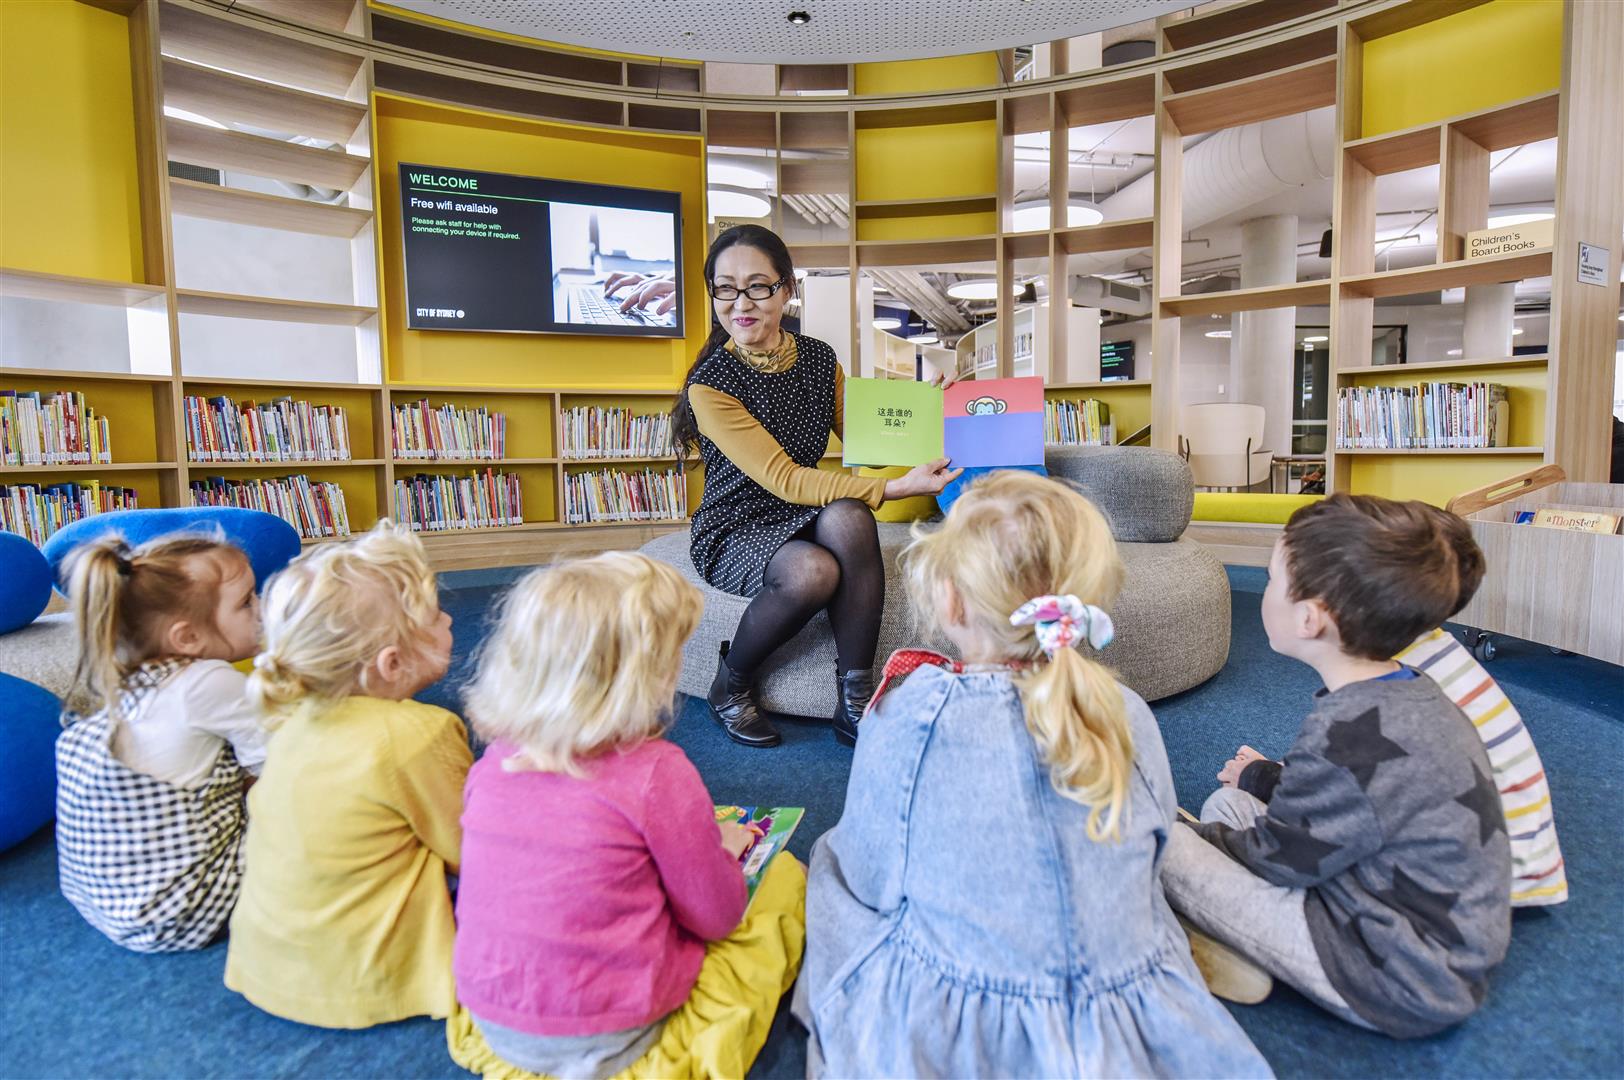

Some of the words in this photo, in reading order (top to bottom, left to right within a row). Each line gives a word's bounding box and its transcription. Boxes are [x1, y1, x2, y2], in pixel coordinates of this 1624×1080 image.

[409, 173, 478, 190] WELCOME
[410, 197, 434, 209] Free
[436, 200, 453, 211] wifi
[455, 203, 498, 215] available
[411, 216, 434, 226] Please
[448, 220, 462, 228] staff
[473, 222, 487, 230] help
[488, 223, 502, 231] with
[412, 226, 449, 236] connecting
[466, 229, 487, 237] device
[493, 232, 521, 240] required.
[1471, 232, 1521, 248] Children's
[1471, 245, 1501, 257] Board
[1503, 241, 1535, 252] Books
[416, 308, 428, 317] CITY
[429, 308, 436, 317] OF
[436, 309, 456, 318] SYDNEY
[877, 407, 912, 417] 这是谁的
